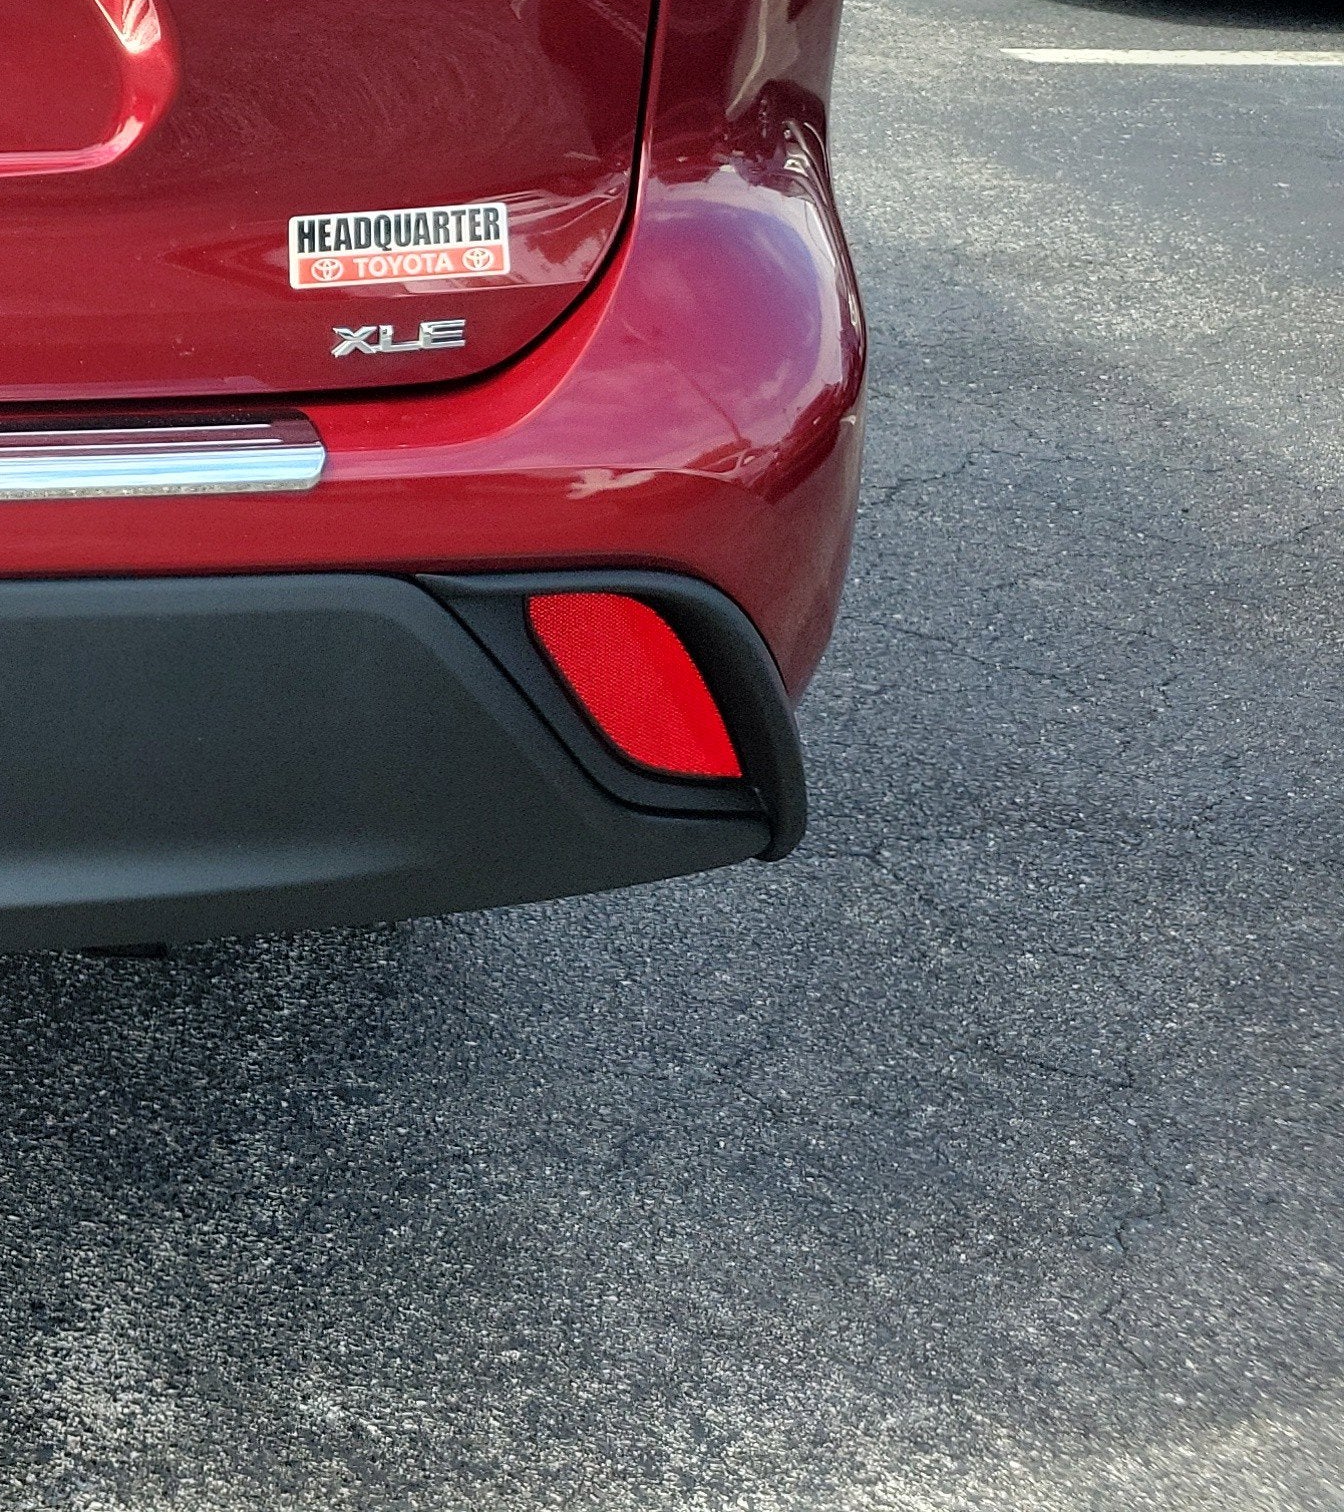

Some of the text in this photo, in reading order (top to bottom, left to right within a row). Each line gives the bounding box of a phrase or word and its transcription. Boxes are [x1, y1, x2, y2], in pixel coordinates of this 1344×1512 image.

[297, 207, 501, 254] HEADQUARTER
[353, 252, 454, 278] TOYOTA
[331, 319, 466, 358] XLE
